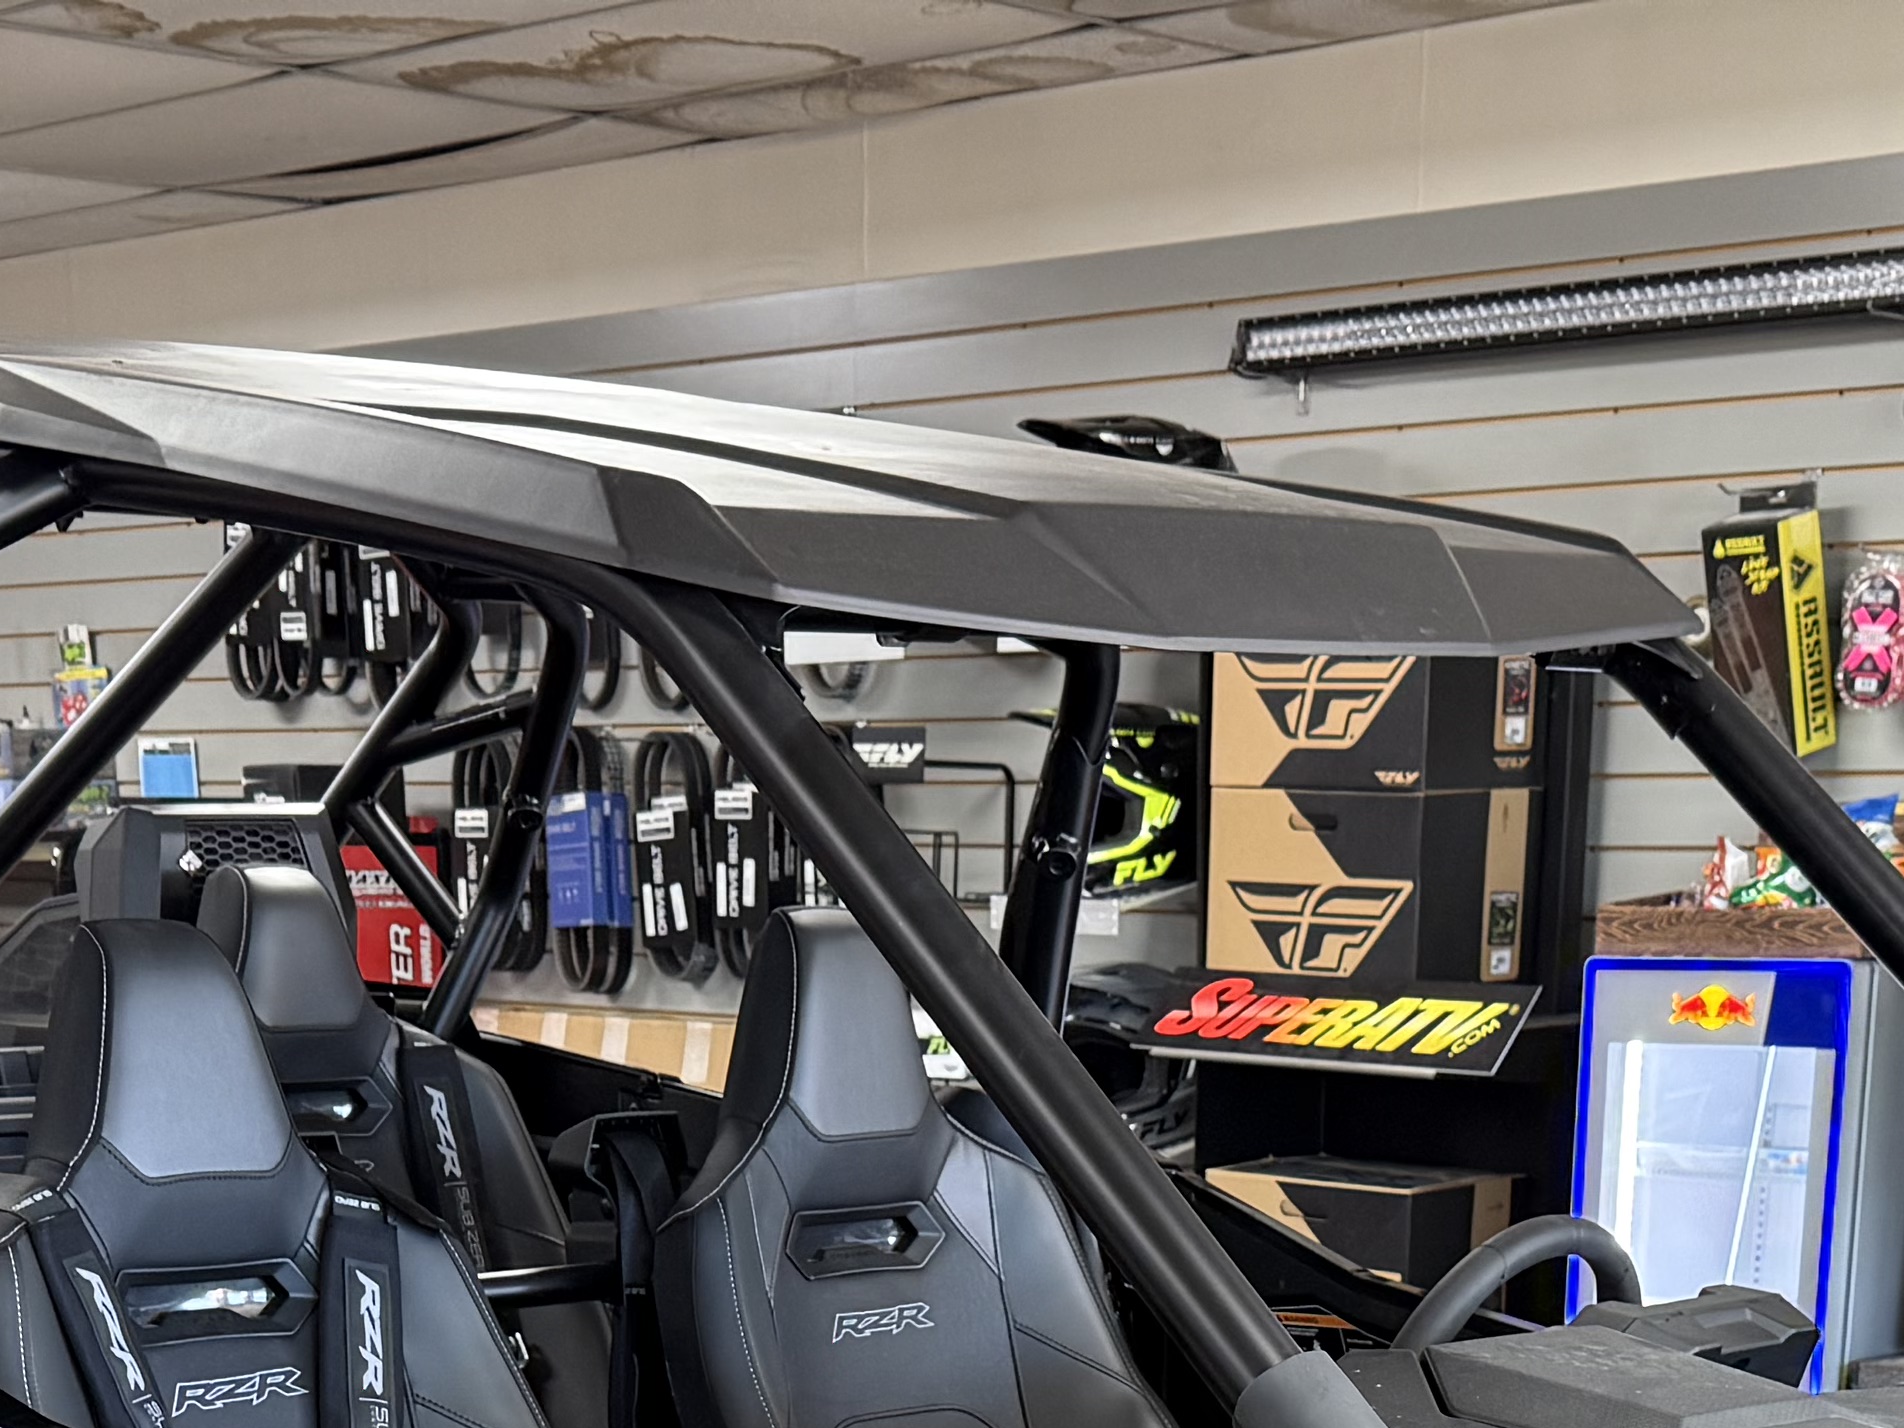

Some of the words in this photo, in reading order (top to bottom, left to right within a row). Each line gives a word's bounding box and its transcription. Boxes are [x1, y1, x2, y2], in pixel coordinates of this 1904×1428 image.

[727, 867, 740, 918] DRIVE
[1113, 850, 1176, 886] FLY
[654, 886, 668, 936] DRIVE
[1153, 978, 1510, 1055] SUPERATV
[1448, 1018, 1501, 1059] .COM
[423, 1084, 463, 1180] RZR
[456, 1187, 475, 1227] SUB
[465, 1228, 485, 1269] ZER
[75, 1267, 146, 1391] RZR
[355, 1269, 384, 1396] RZR
[832, 1302, 936, 1344] RZR
[172, 1366, 310, 1418] RZR
